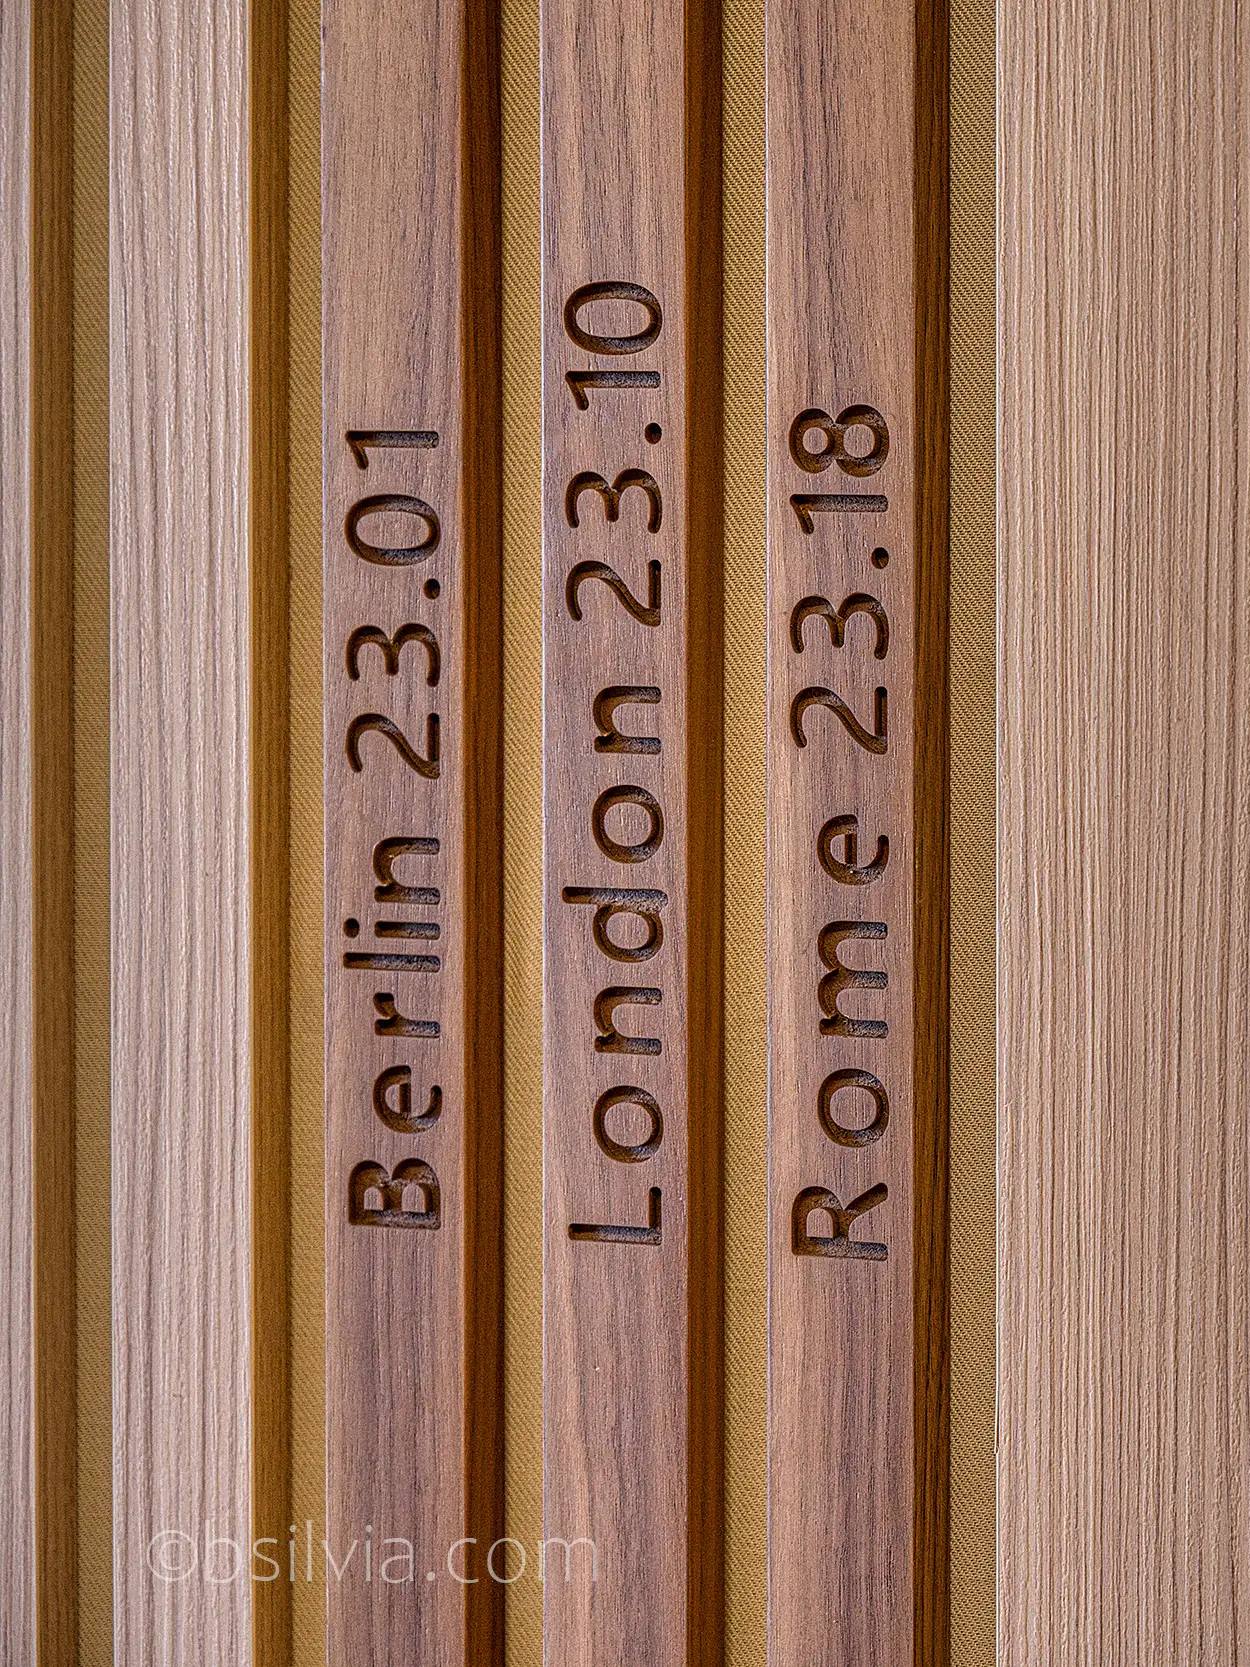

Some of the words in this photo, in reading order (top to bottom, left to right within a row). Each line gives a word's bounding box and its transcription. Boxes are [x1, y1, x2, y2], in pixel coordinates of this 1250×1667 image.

[344, 428, 441, 779] 23.01
[563, 279, 664, 626] 23.10
[787, 402, 891, 755] 23.18
[342, 836, 442, 1230] Berlin
[562, 685, 669, 1245] London
[790, 813, 890, 1261] Rome
